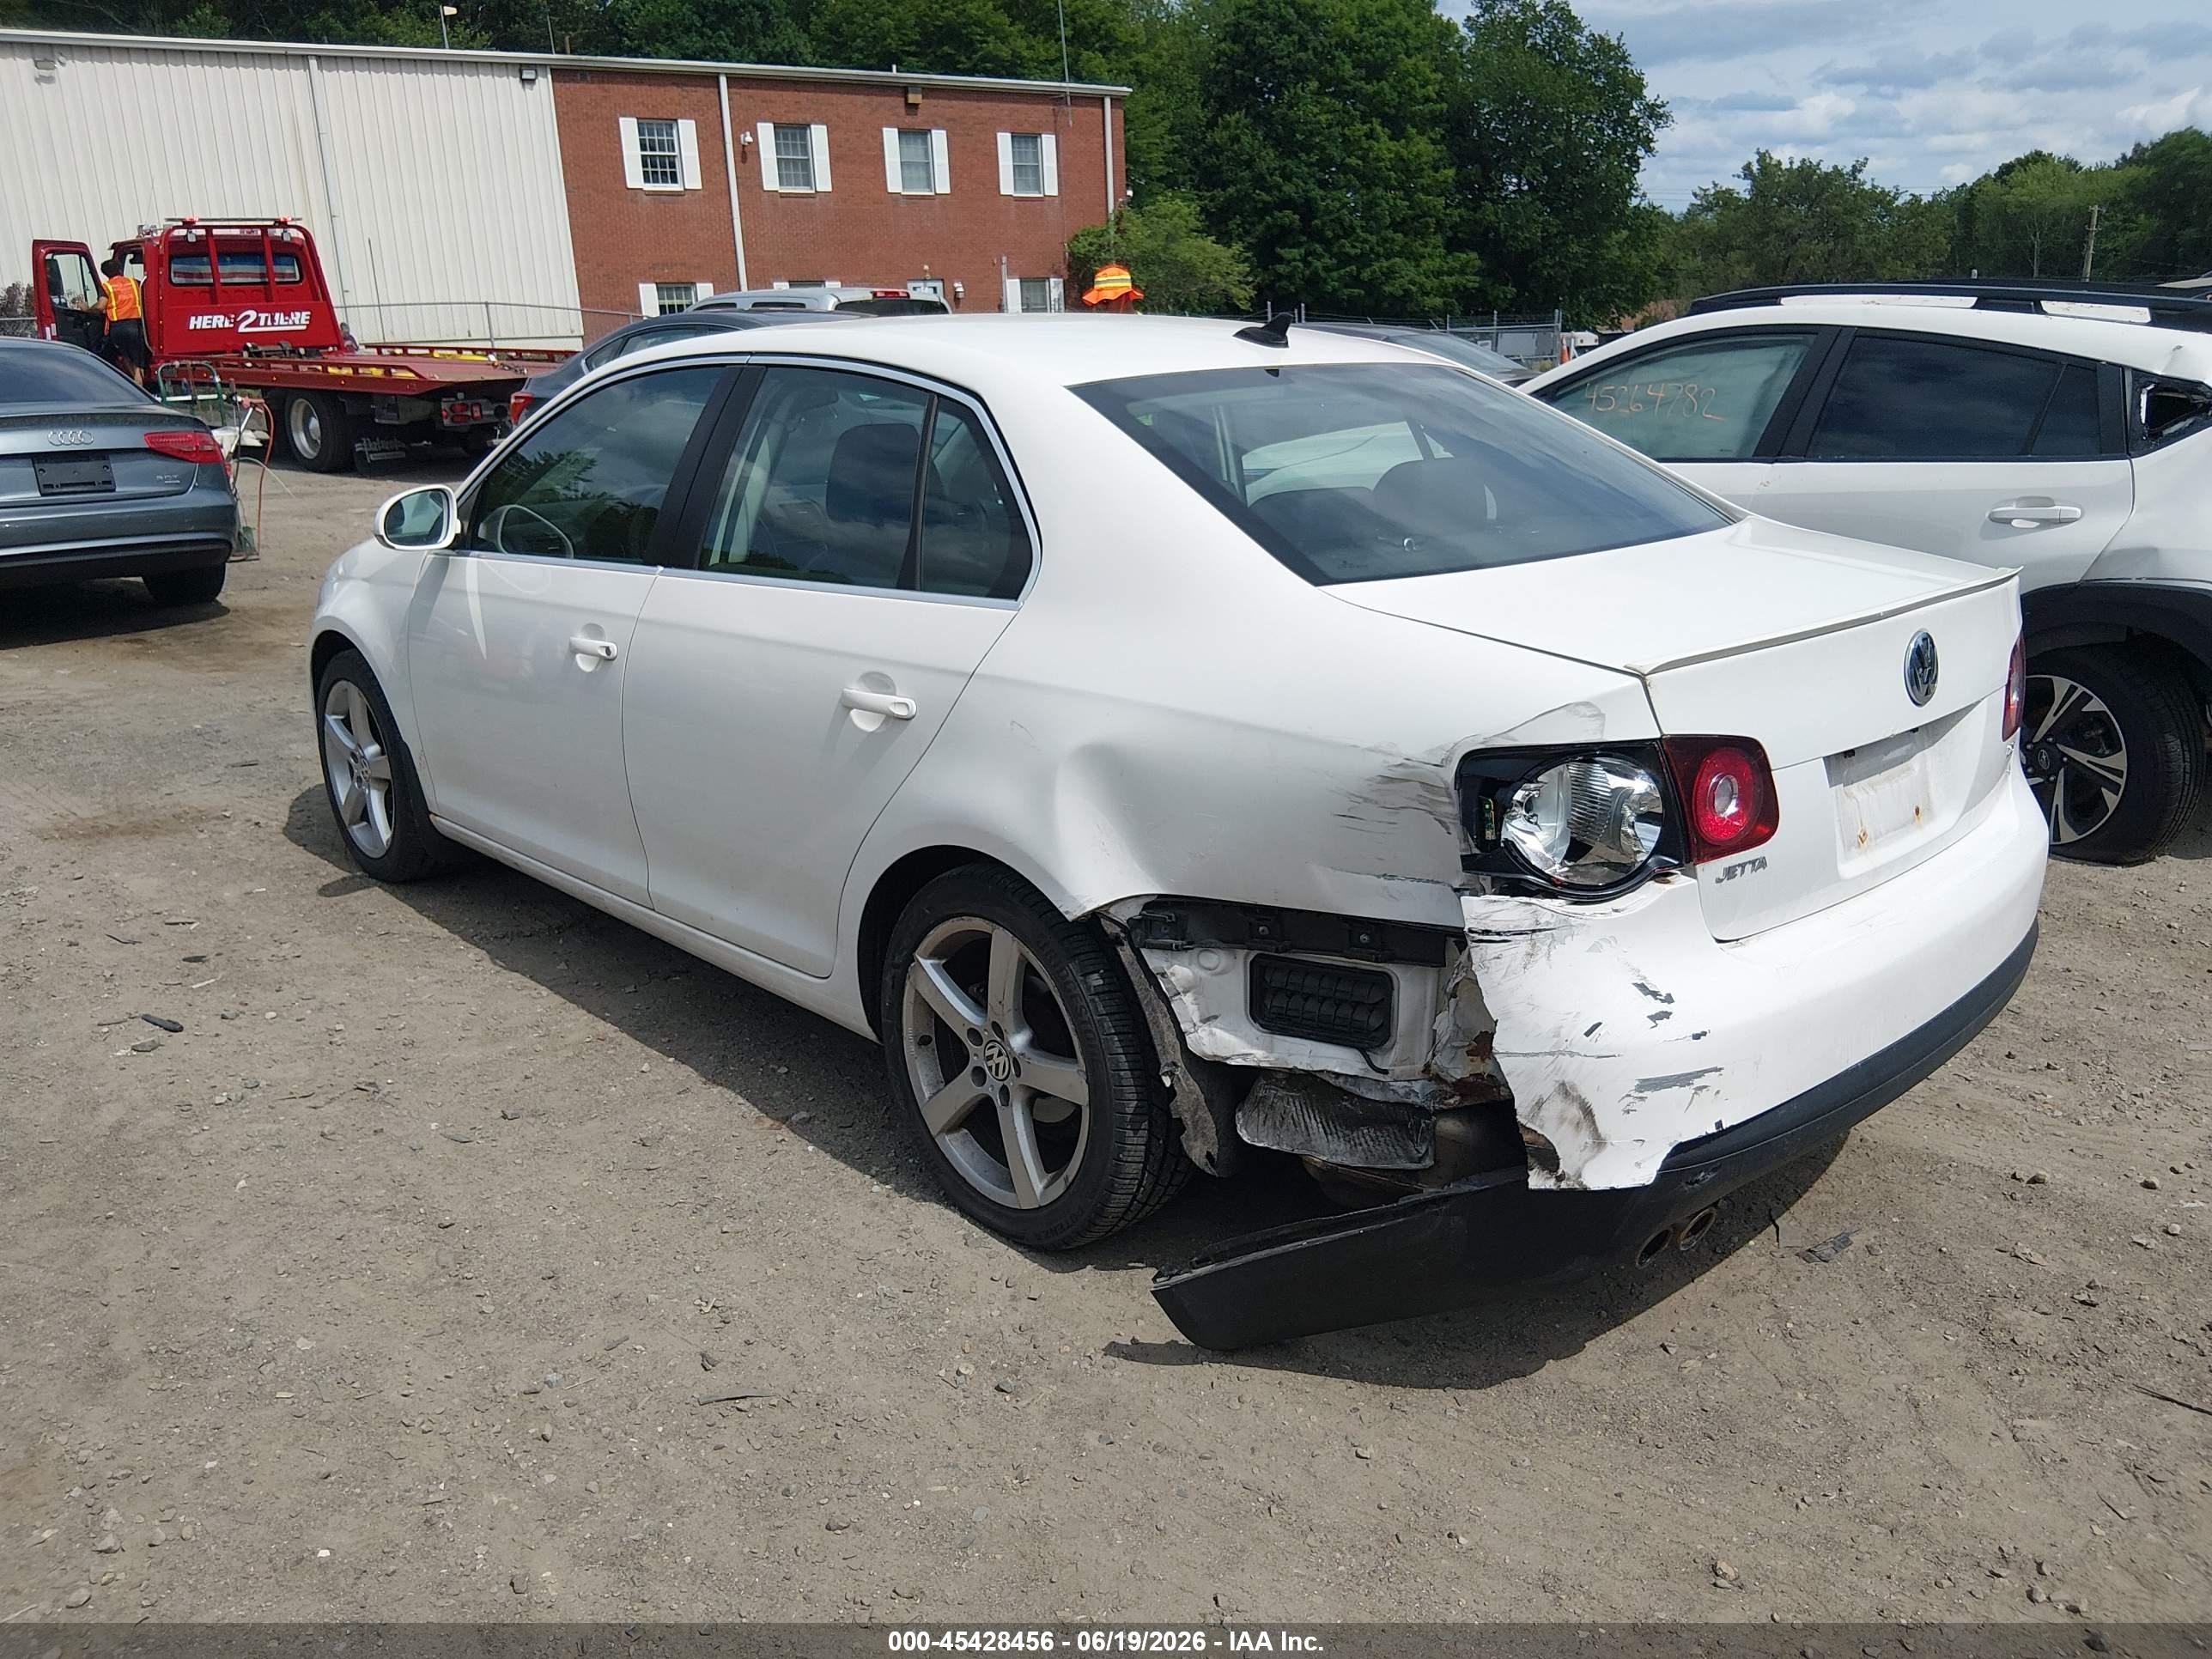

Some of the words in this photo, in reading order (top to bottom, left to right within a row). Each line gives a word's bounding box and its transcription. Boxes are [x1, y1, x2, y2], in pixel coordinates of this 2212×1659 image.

[189, 314, 235, 330] HERE
[236, 309, 258, 333] 2
[1715, 855, 1768, 884] JETTA
